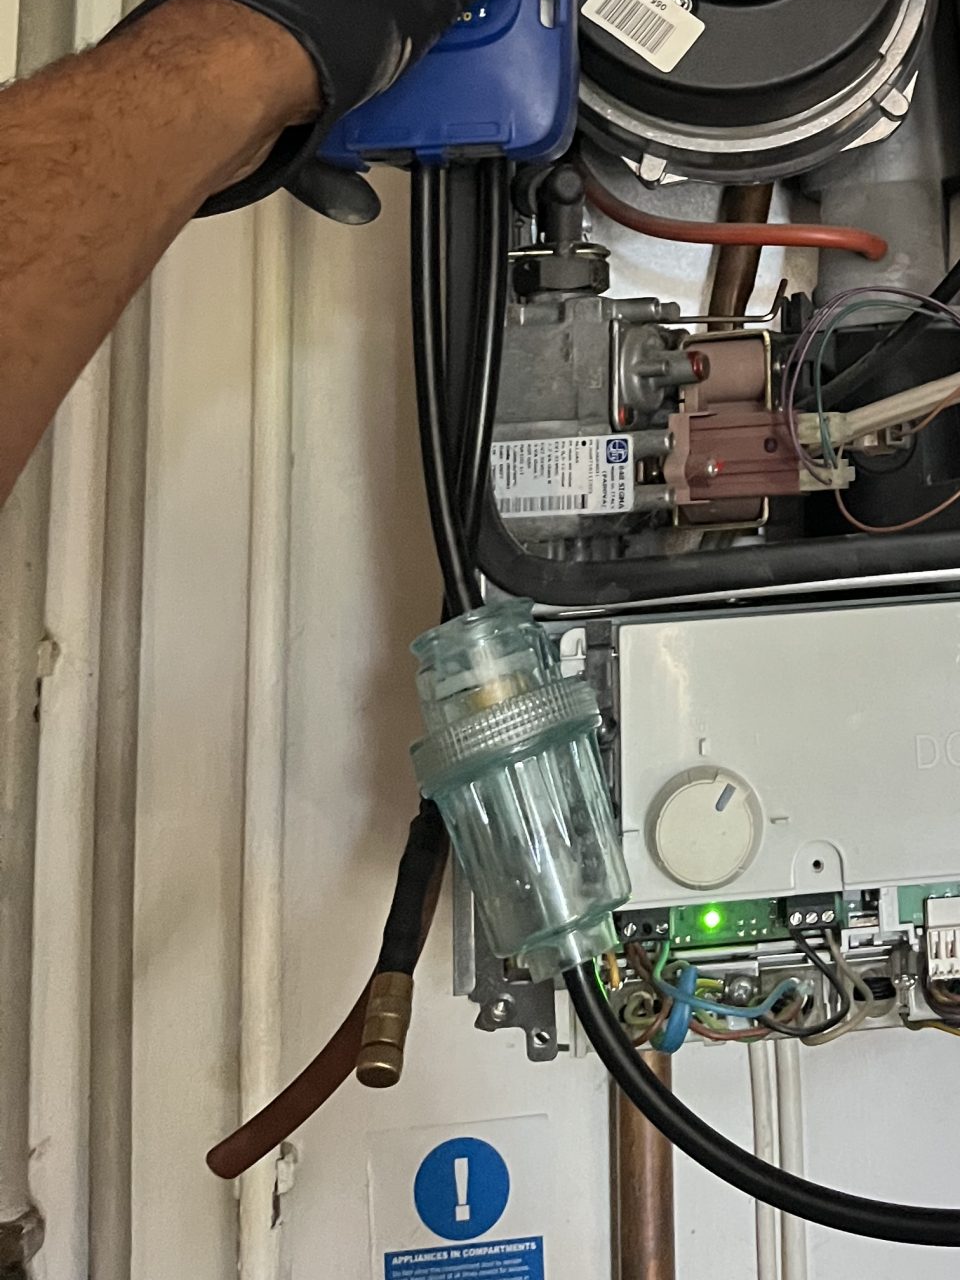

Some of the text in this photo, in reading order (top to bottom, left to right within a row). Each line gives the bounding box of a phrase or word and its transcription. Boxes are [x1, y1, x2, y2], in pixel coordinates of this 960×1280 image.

[391, 1241, 538, 1265] APPLIANCES IN COMPARTMENTS
